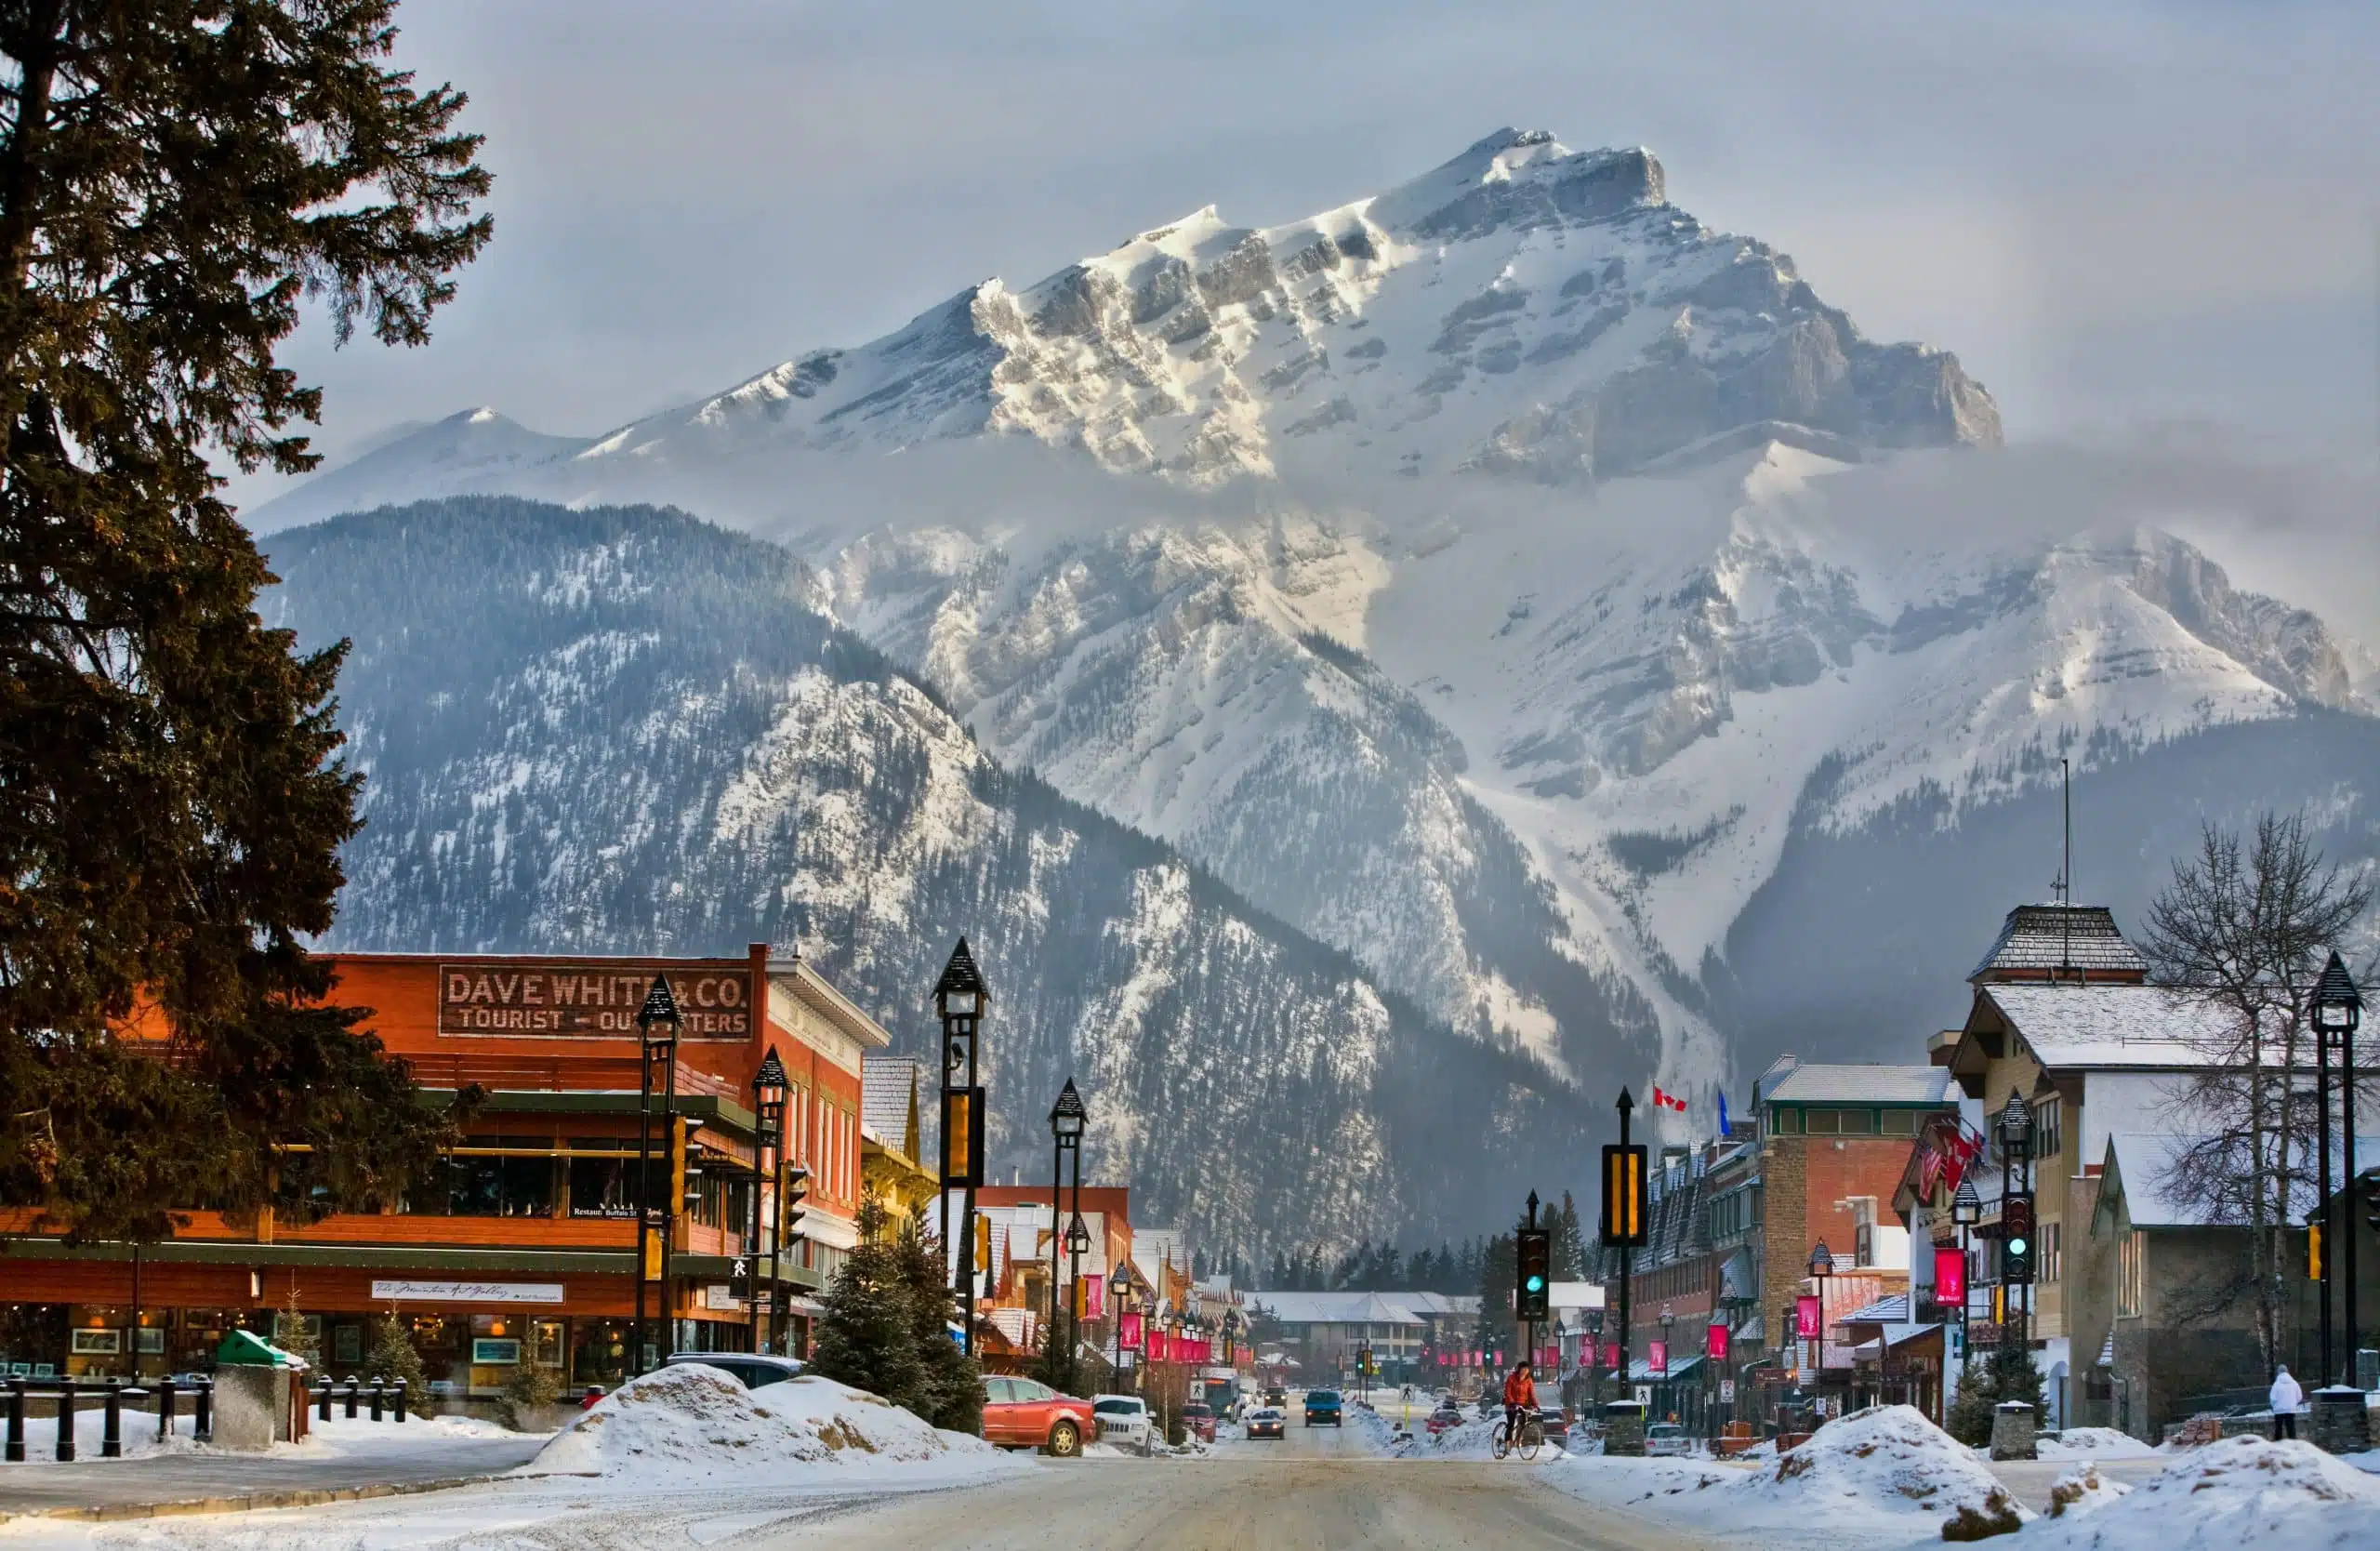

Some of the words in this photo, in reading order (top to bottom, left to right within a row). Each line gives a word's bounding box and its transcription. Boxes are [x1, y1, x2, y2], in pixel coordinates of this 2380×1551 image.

[448, 974, 544, 1004] DAVE
[673, 980, 691, 1007] &
[696, 977, 747, 1008] CO.
[458, 1007, 564, 1029] TOURIST
[600, 1011, 747, 1033] OUTERS
